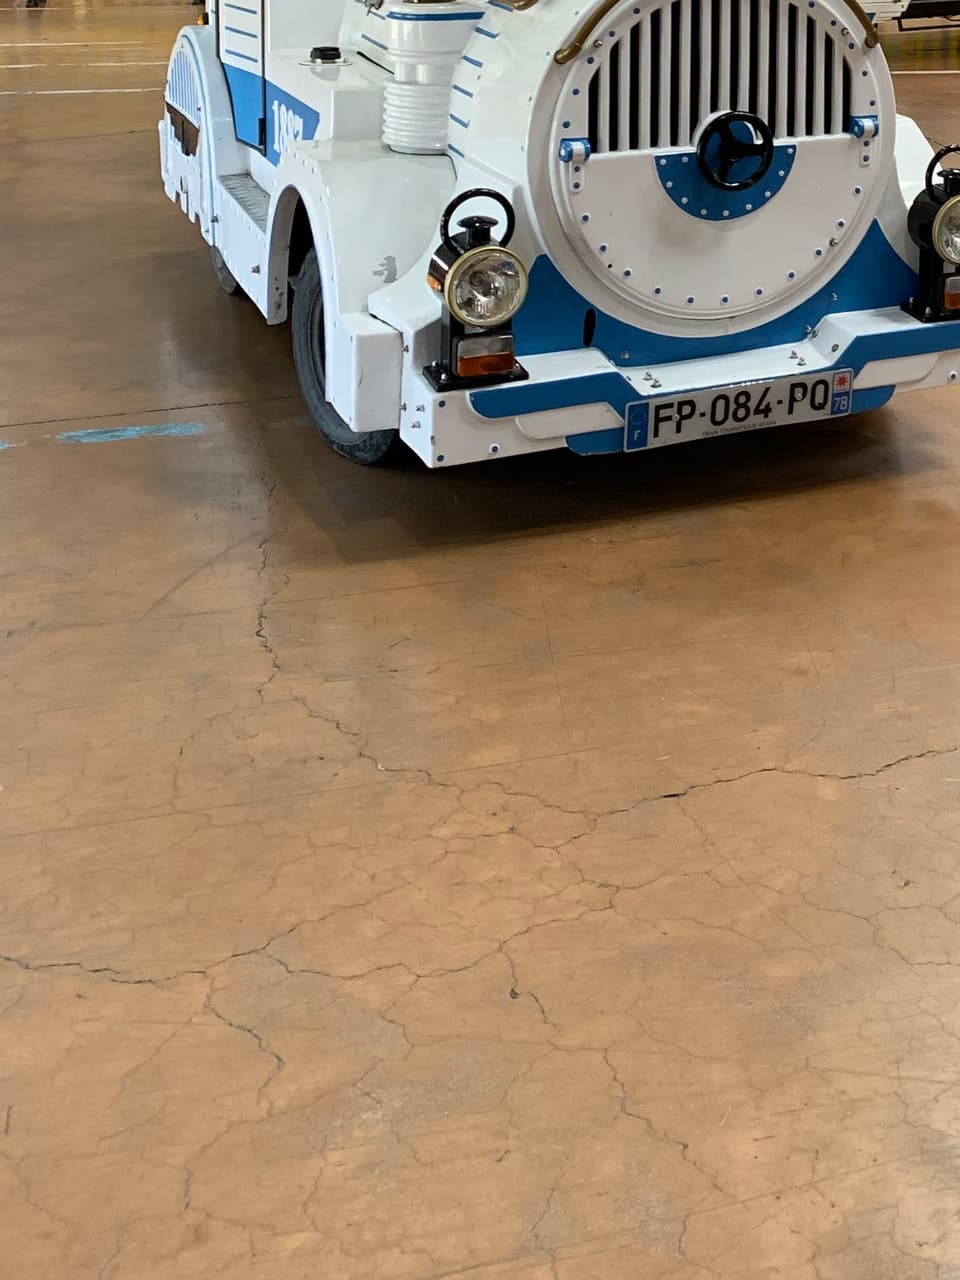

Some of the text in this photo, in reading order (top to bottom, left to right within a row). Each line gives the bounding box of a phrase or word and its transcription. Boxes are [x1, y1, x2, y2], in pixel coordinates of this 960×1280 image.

[633, 378, 848, 441] F FP-084-PQ 78
